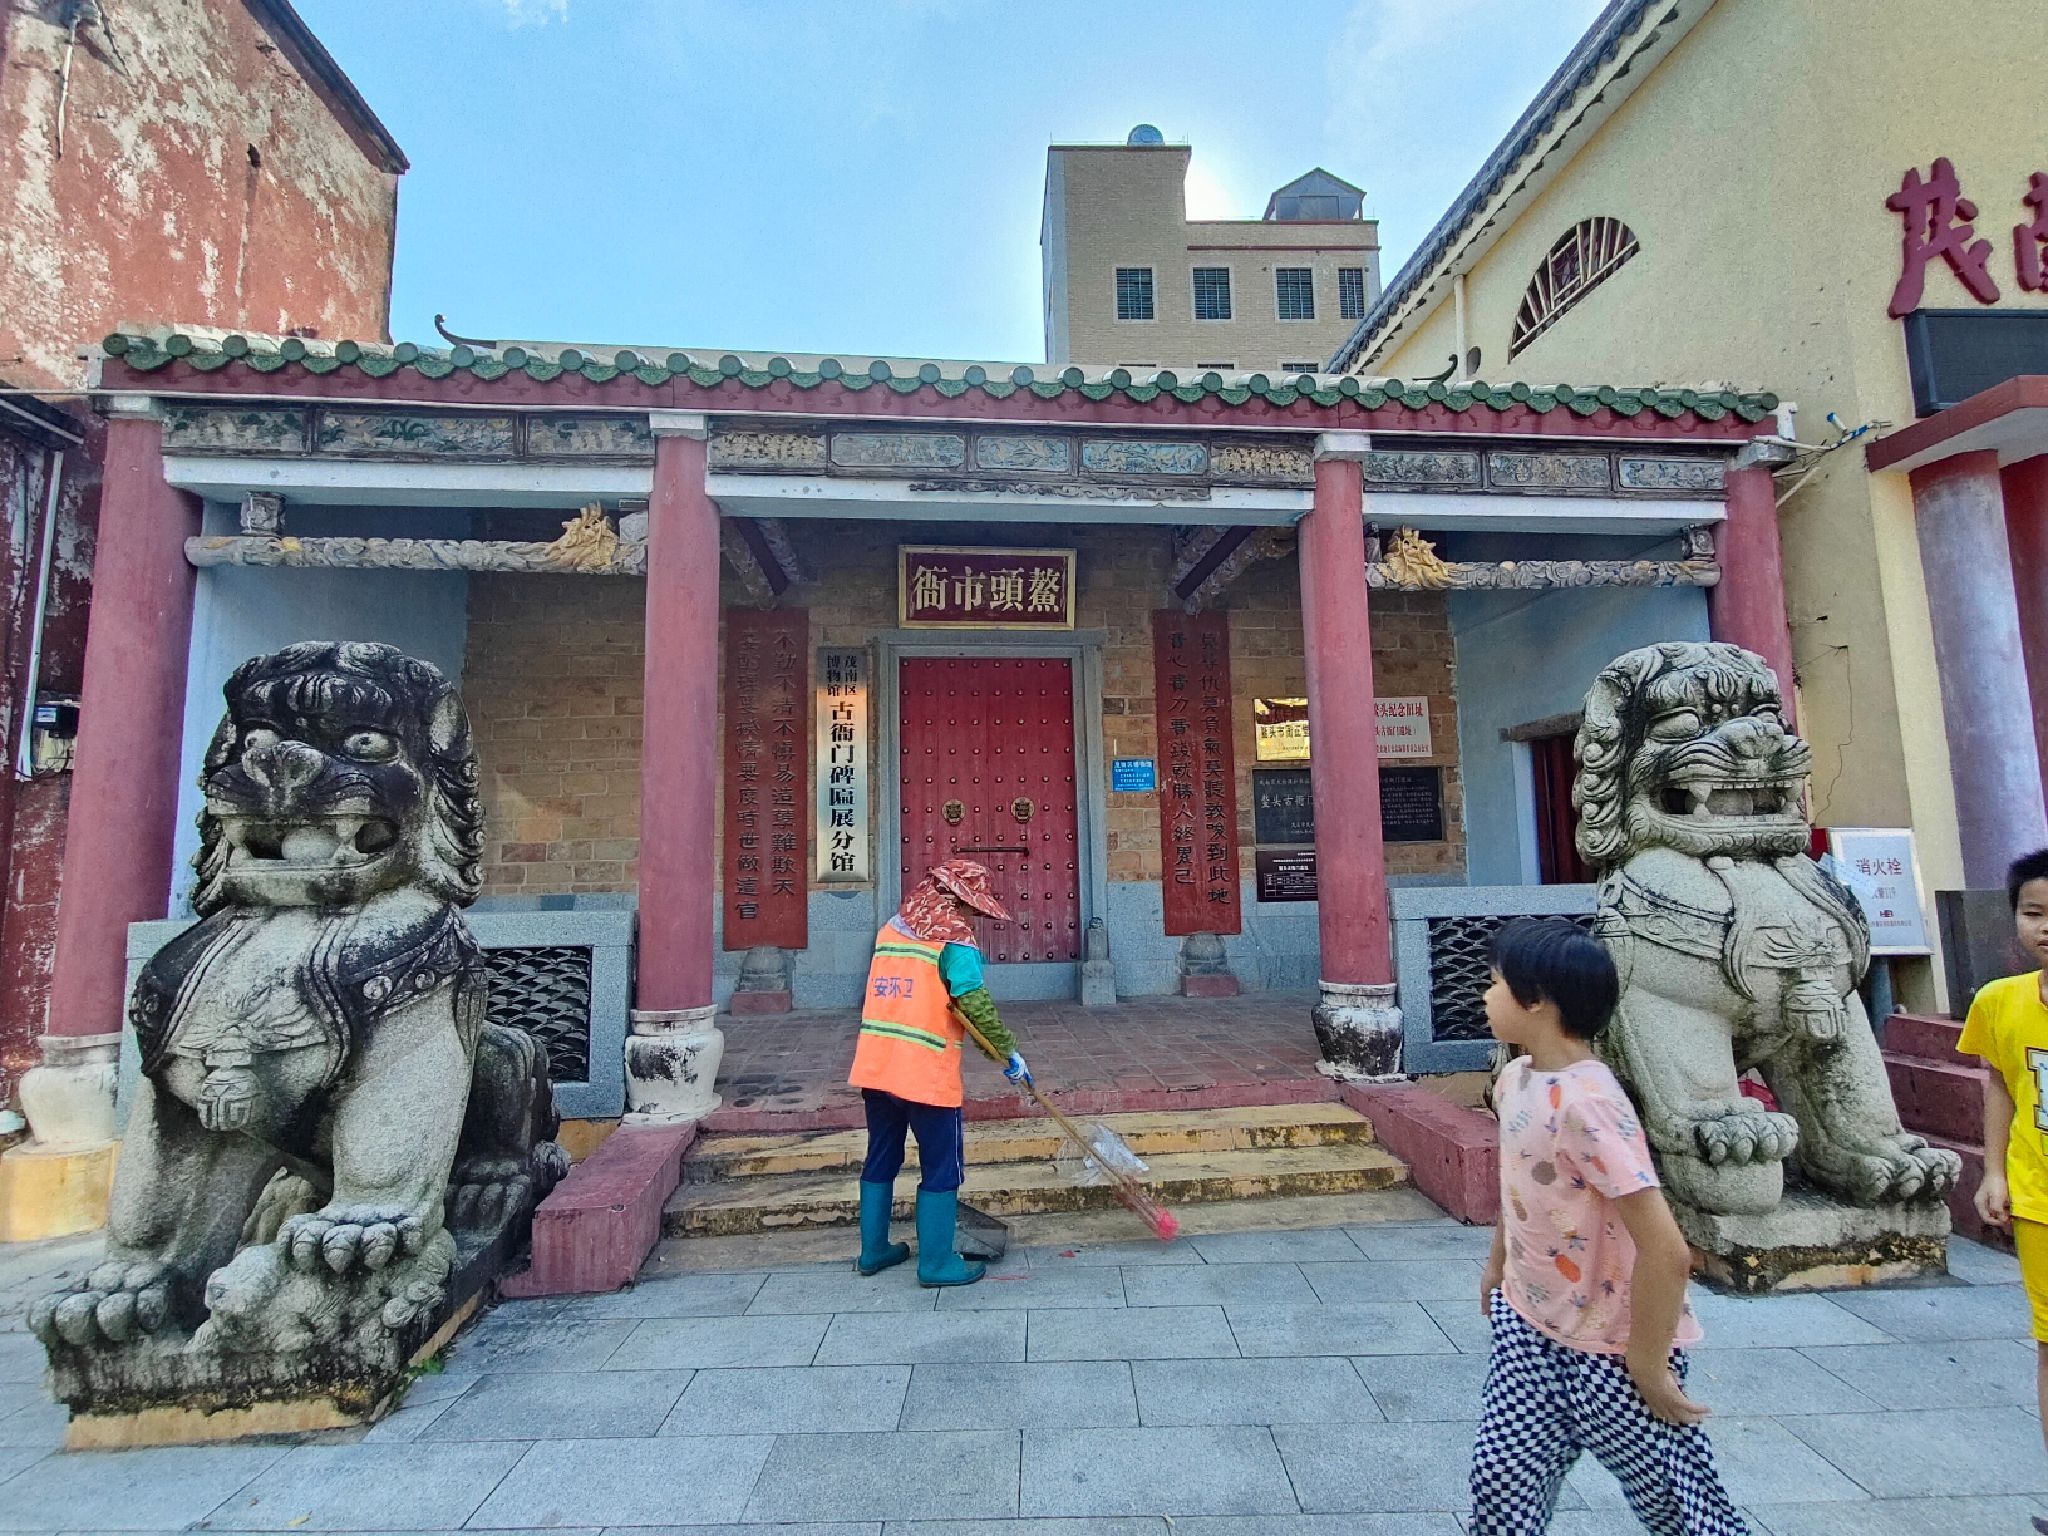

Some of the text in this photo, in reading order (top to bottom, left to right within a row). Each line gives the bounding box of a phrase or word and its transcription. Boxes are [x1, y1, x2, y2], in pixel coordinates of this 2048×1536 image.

[827, 655, 841, 697] 博物馆
[844, 655, 858, 696] 茂南区
[1856, 857, 1903, 876] 消火栓
